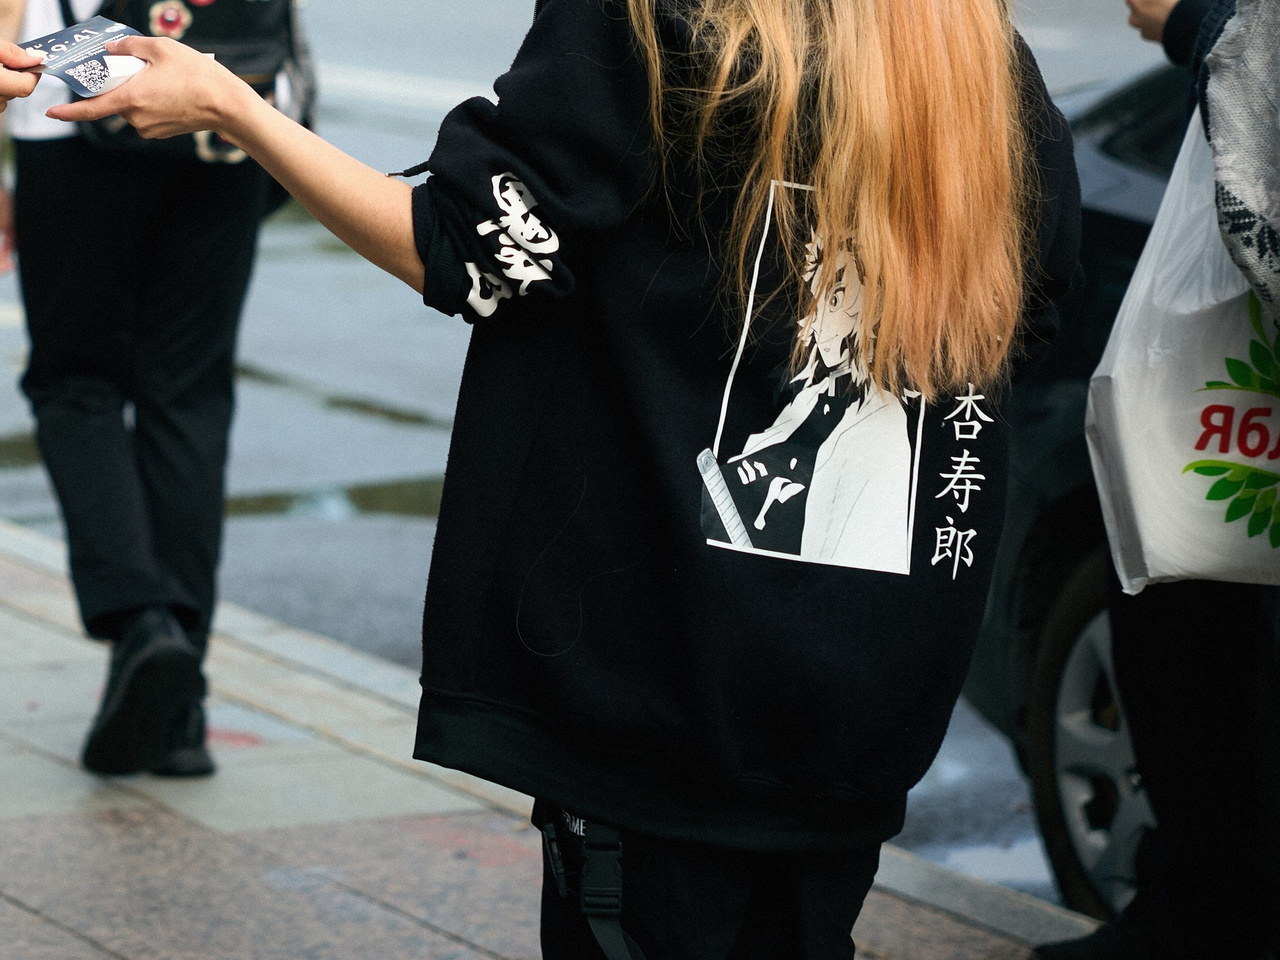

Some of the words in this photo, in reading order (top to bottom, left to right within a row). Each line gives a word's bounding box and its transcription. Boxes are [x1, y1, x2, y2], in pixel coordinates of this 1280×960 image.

[50, 29, 99, 53] 9:41
[1194, 404, 1280, 461] Яб
[930, 382, 995, 581] 杏寿郎
